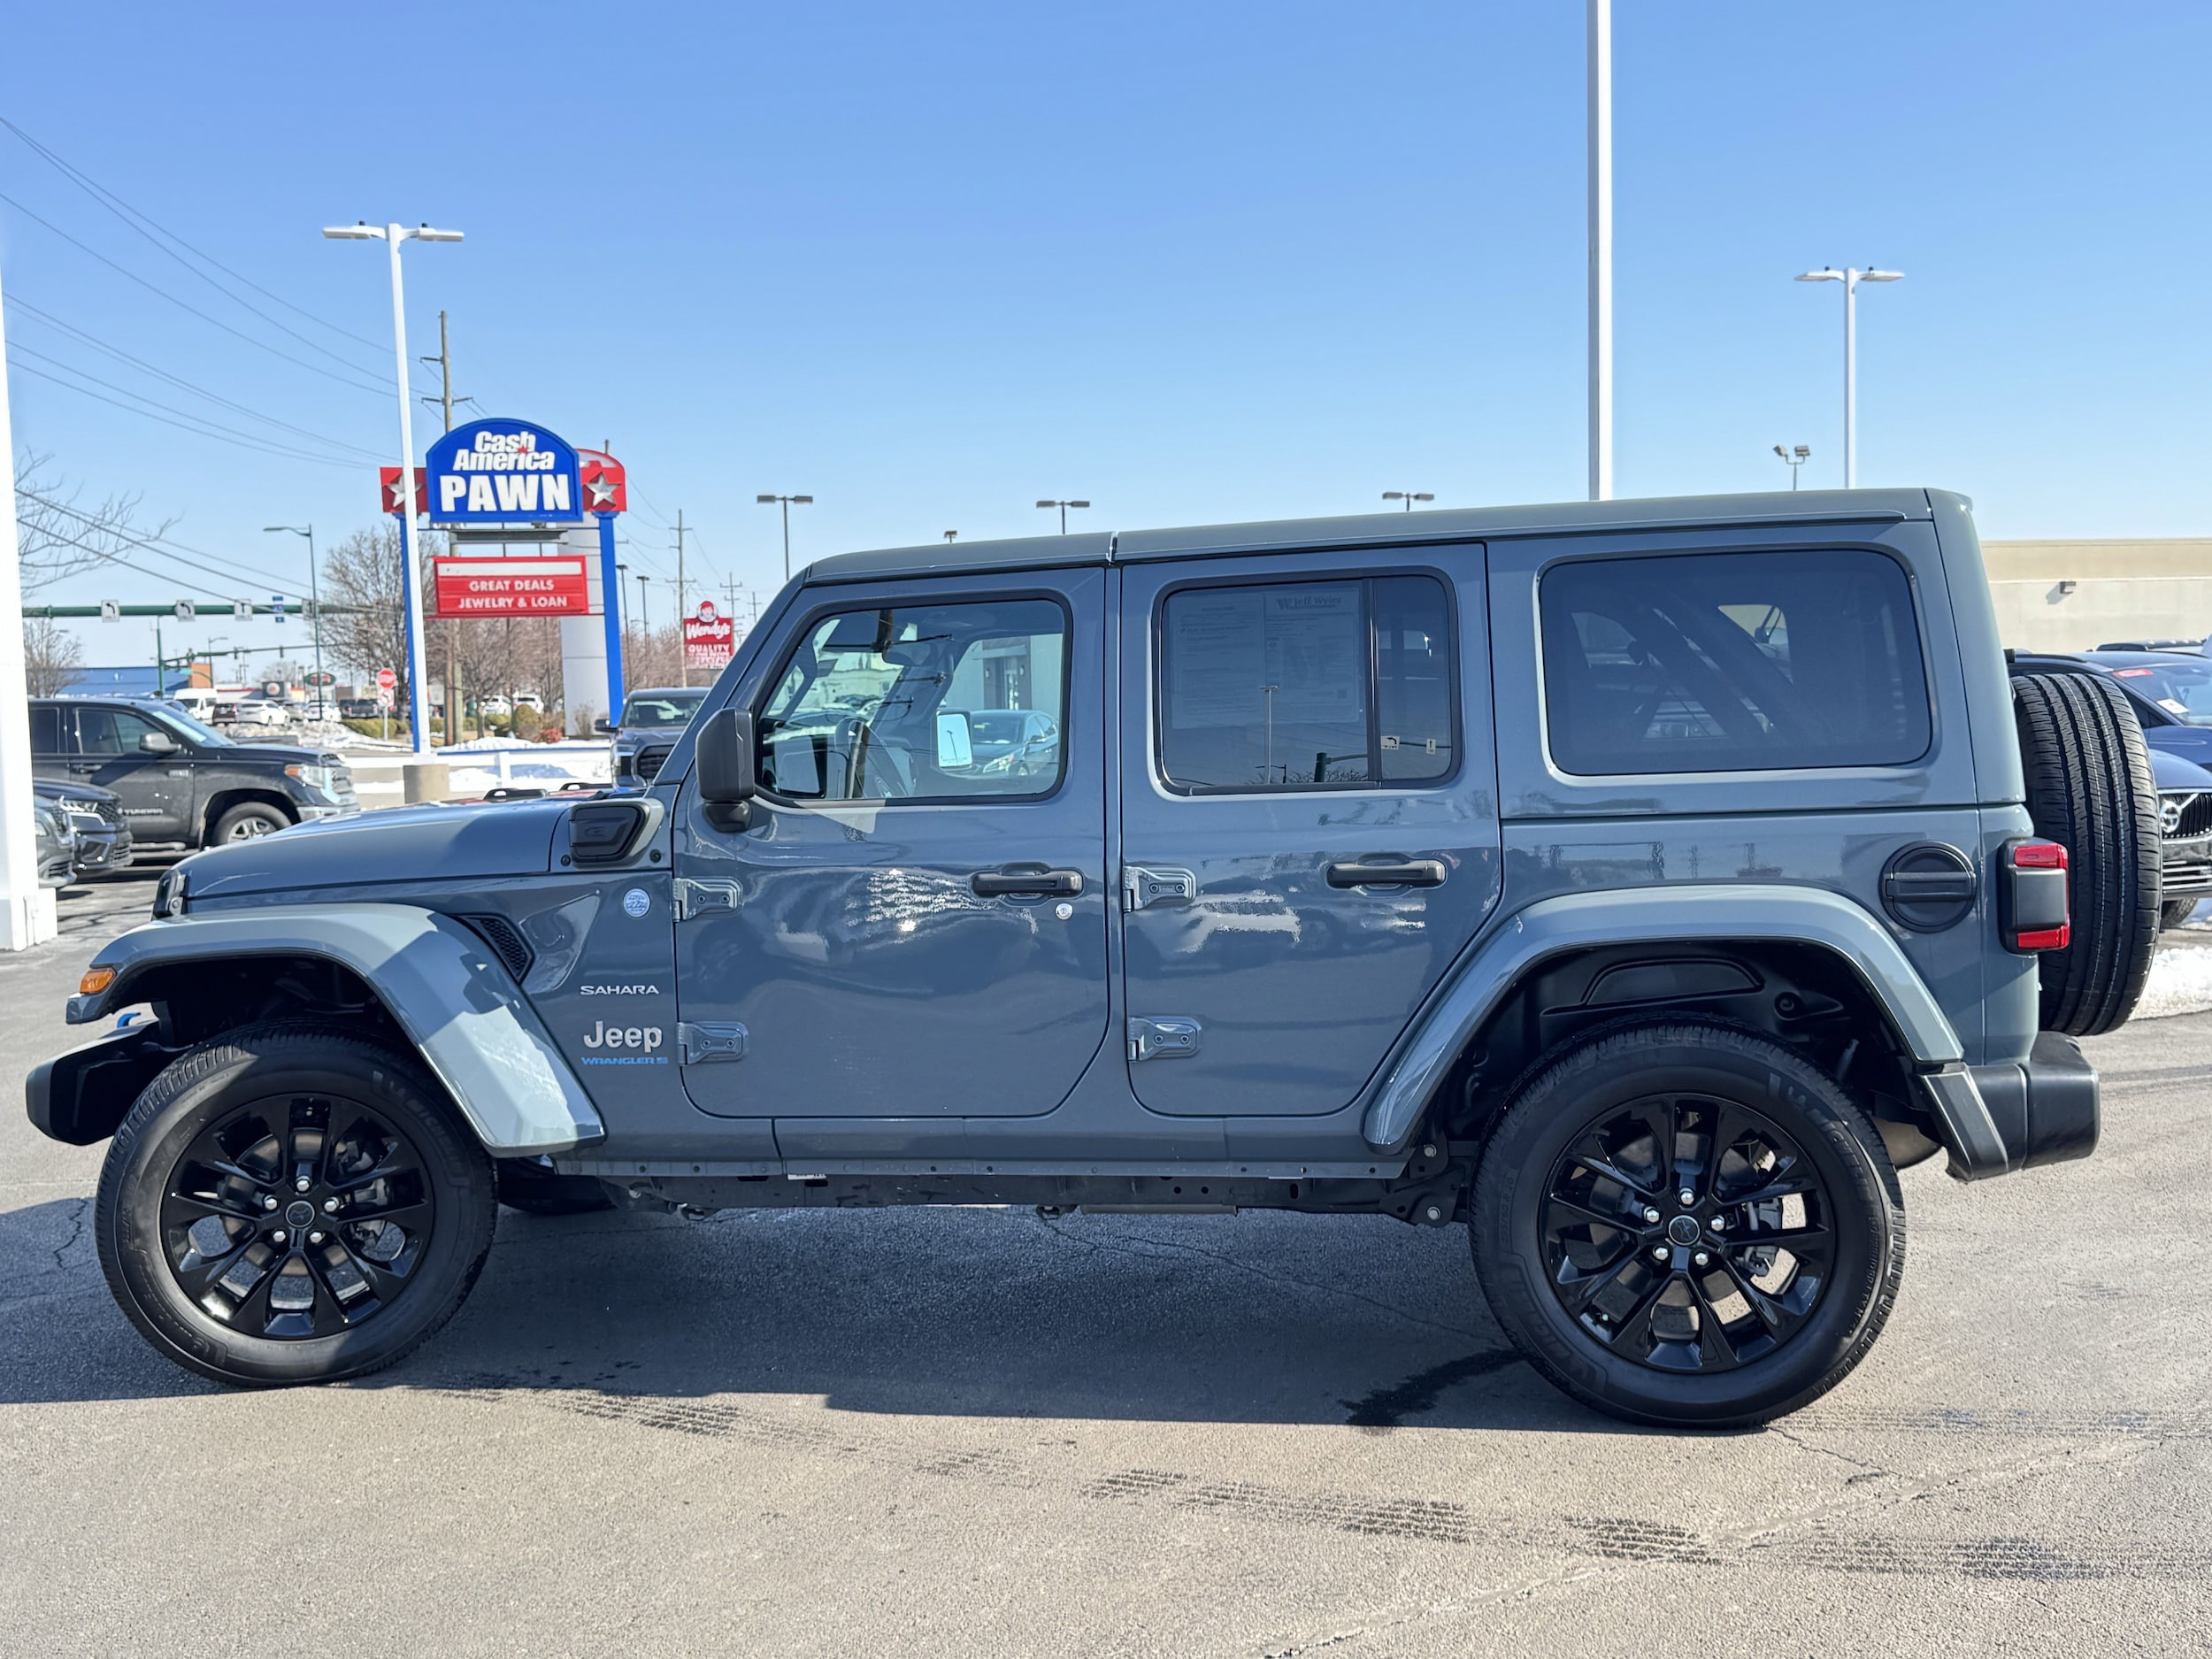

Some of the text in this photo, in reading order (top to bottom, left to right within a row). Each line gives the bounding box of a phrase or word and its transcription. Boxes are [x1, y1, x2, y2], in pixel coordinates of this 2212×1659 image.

[474, 431, 536, 452] Cash
[452, 449, 556, 471] America
[439, 474, 571, 512] PAWN
[469, 580, 554, 592] GREAT DEALS
[458, 596, 567, 610] JEWELRY & LOAN
[686, 620, 731, 640] Wendy's
[687, 644, 730, 654] QUALITY
[580, 985, 660, 995] SAHARA
[583, 1020, 663, 1053] Jeep
[580, 1056, 655, 1065] WRANGLER
